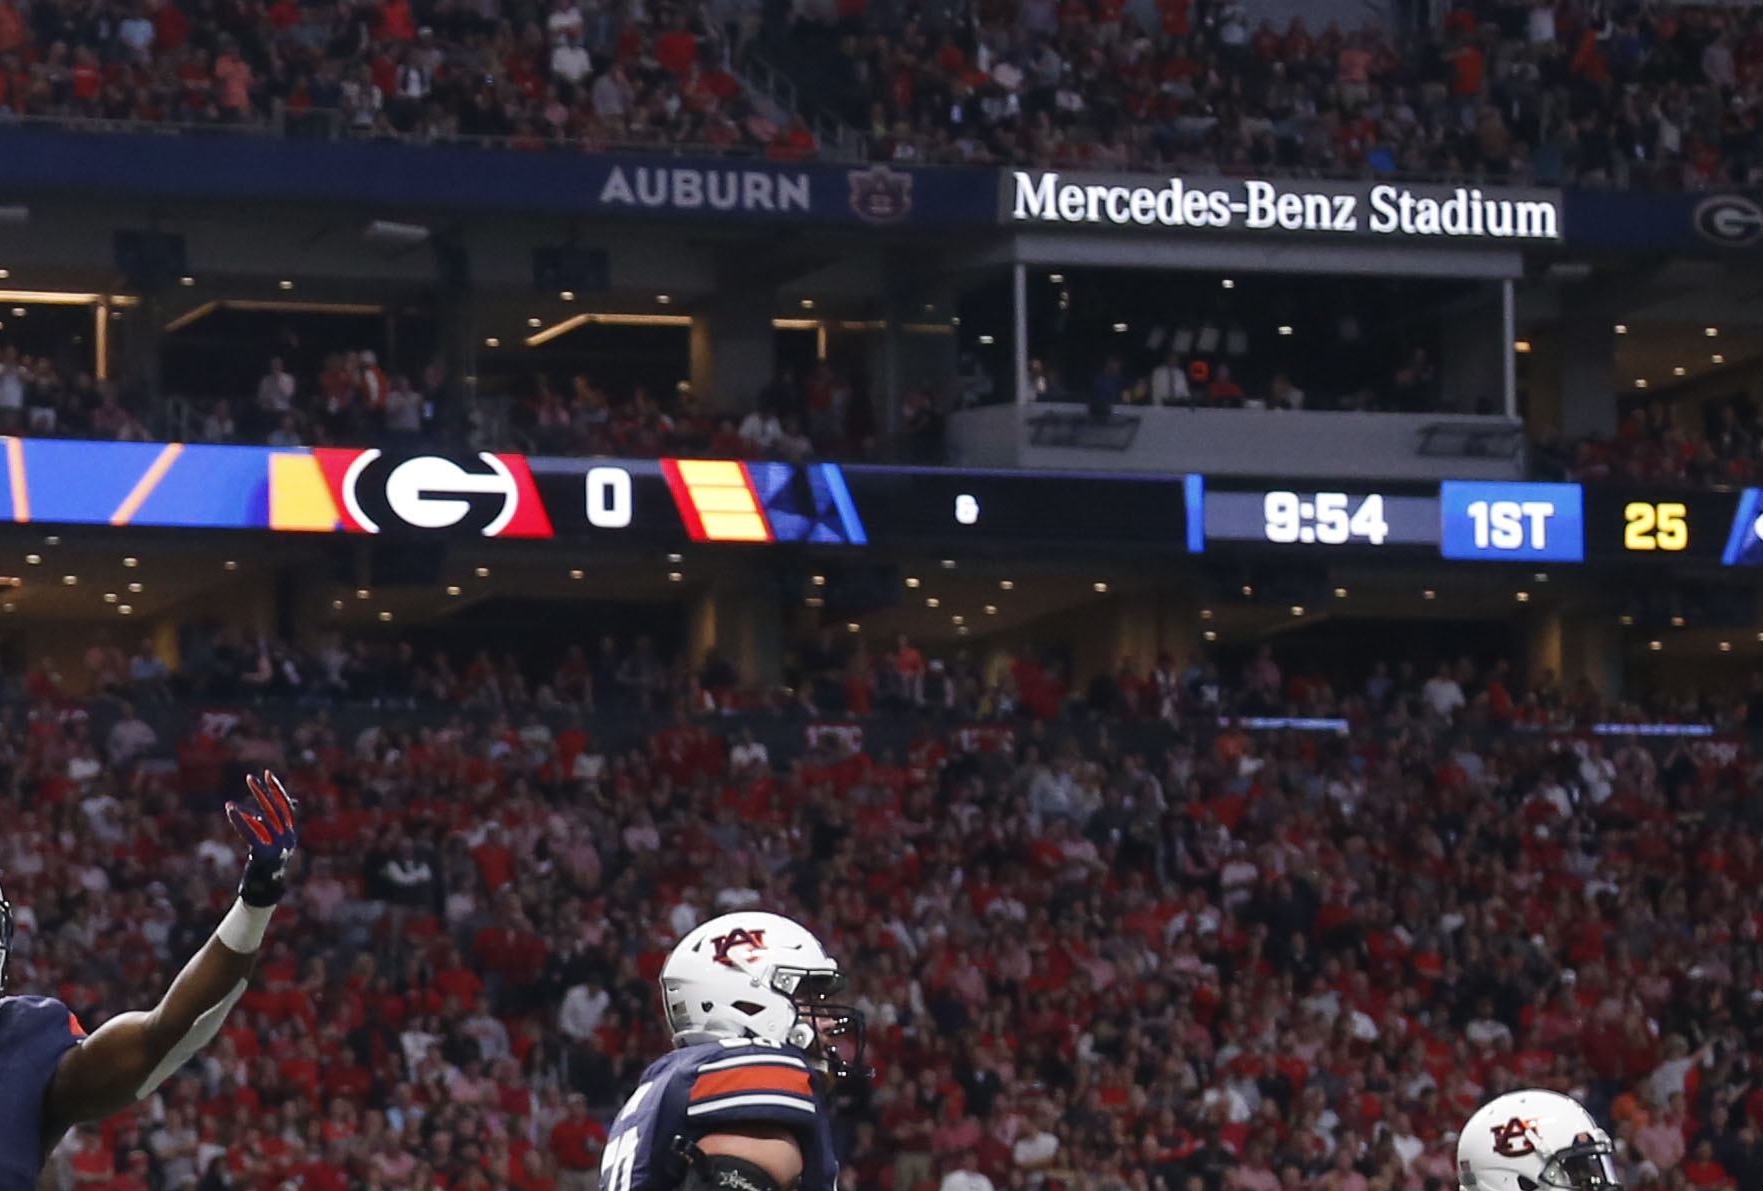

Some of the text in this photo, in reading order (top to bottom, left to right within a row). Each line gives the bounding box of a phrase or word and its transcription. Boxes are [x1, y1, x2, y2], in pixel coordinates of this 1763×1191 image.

[599, 166, 811, 212] AUBURN
[1012, 171, 1560, 239] Mercedes-Benz Stadium
[586, 467, 632, 528] 0
[1264, 491, 1388, 546] 9:54
[1469, 501, 1554, 550] 1ST
[1624, 502, 1688, 550] 25
